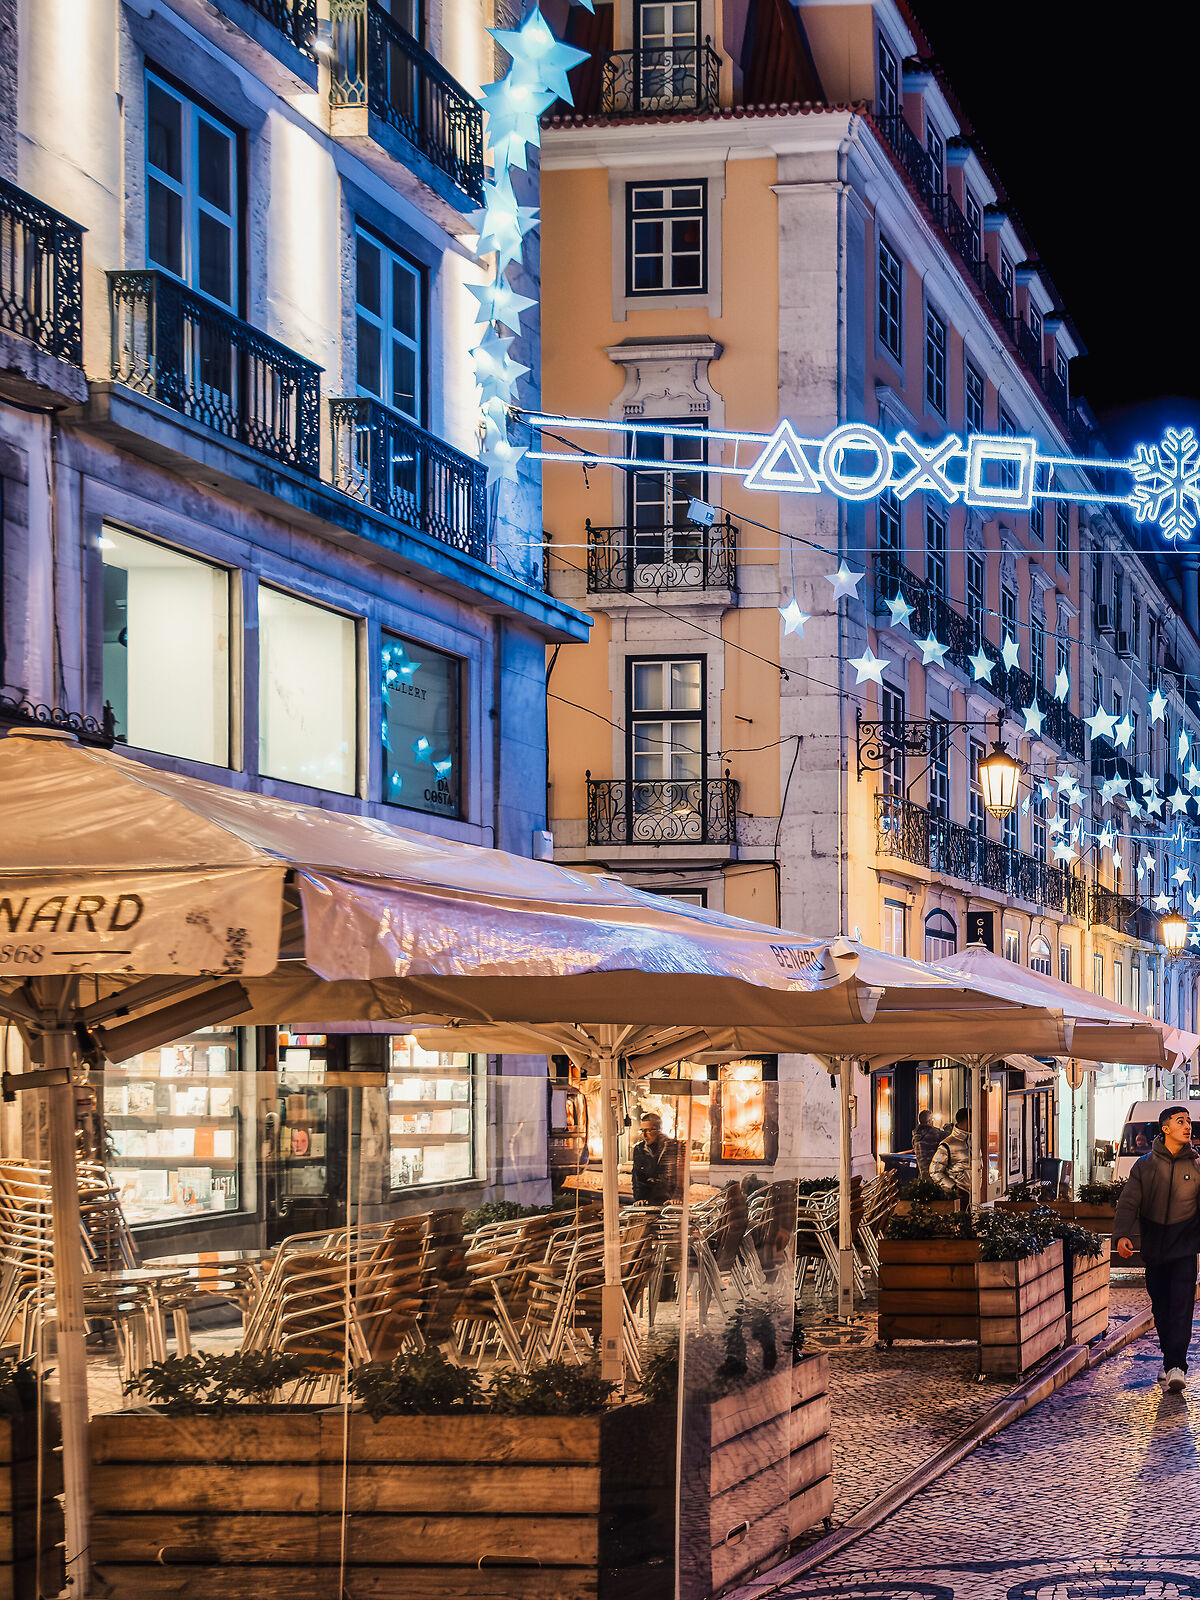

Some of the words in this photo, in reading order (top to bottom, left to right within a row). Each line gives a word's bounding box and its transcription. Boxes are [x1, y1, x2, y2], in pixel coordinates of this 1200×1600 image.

[385, 677, 427, 700] ALLERY
[424, 788, 453, 806] COSTA
[0, 894, 144, 932] NARD
